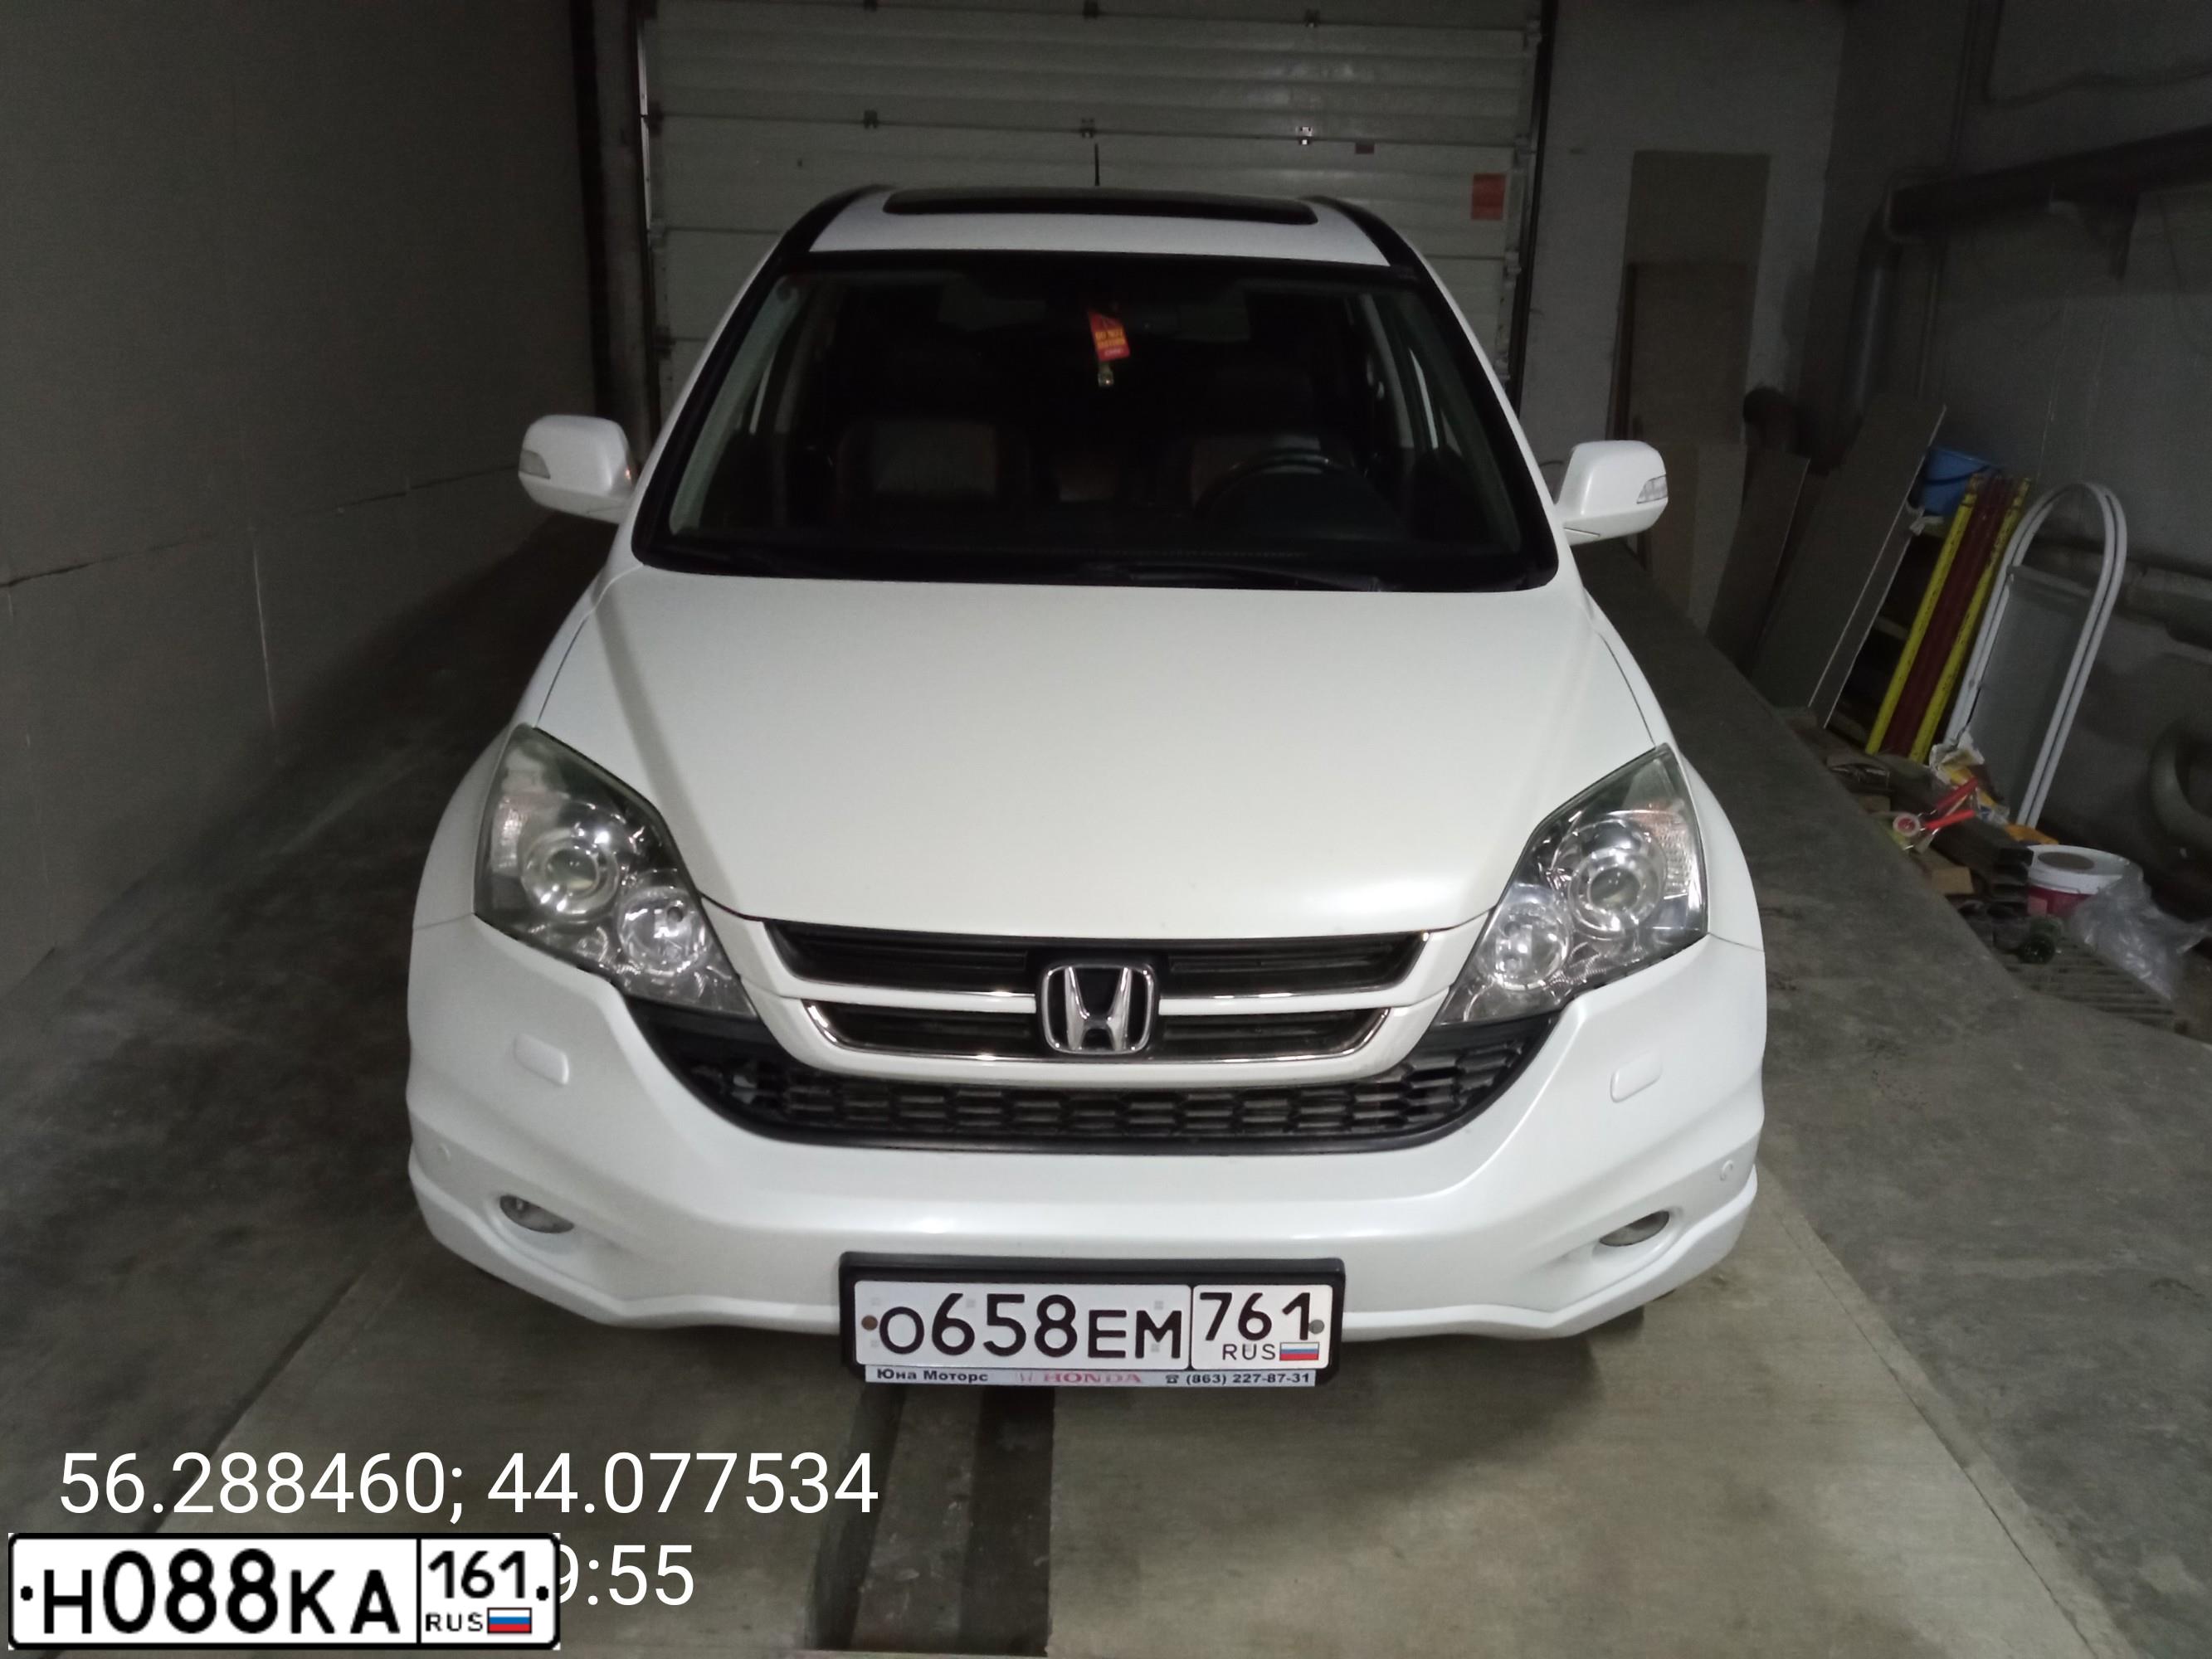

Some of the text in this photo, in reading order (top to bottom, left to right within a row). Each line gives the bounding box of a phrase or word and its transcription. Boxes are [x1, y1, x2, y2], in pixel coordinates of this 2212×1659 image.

[879, 1292, 1311, 1359] О658ЕМ 761
[1222, 1343, 1276, 1360] RUS
[877, 1369, 988, 1384] Юна Моторс
[1043, 1373, 1143, 1384] HONDA
[1186, 1373, 1310, 1384] (863) 227-87-31
